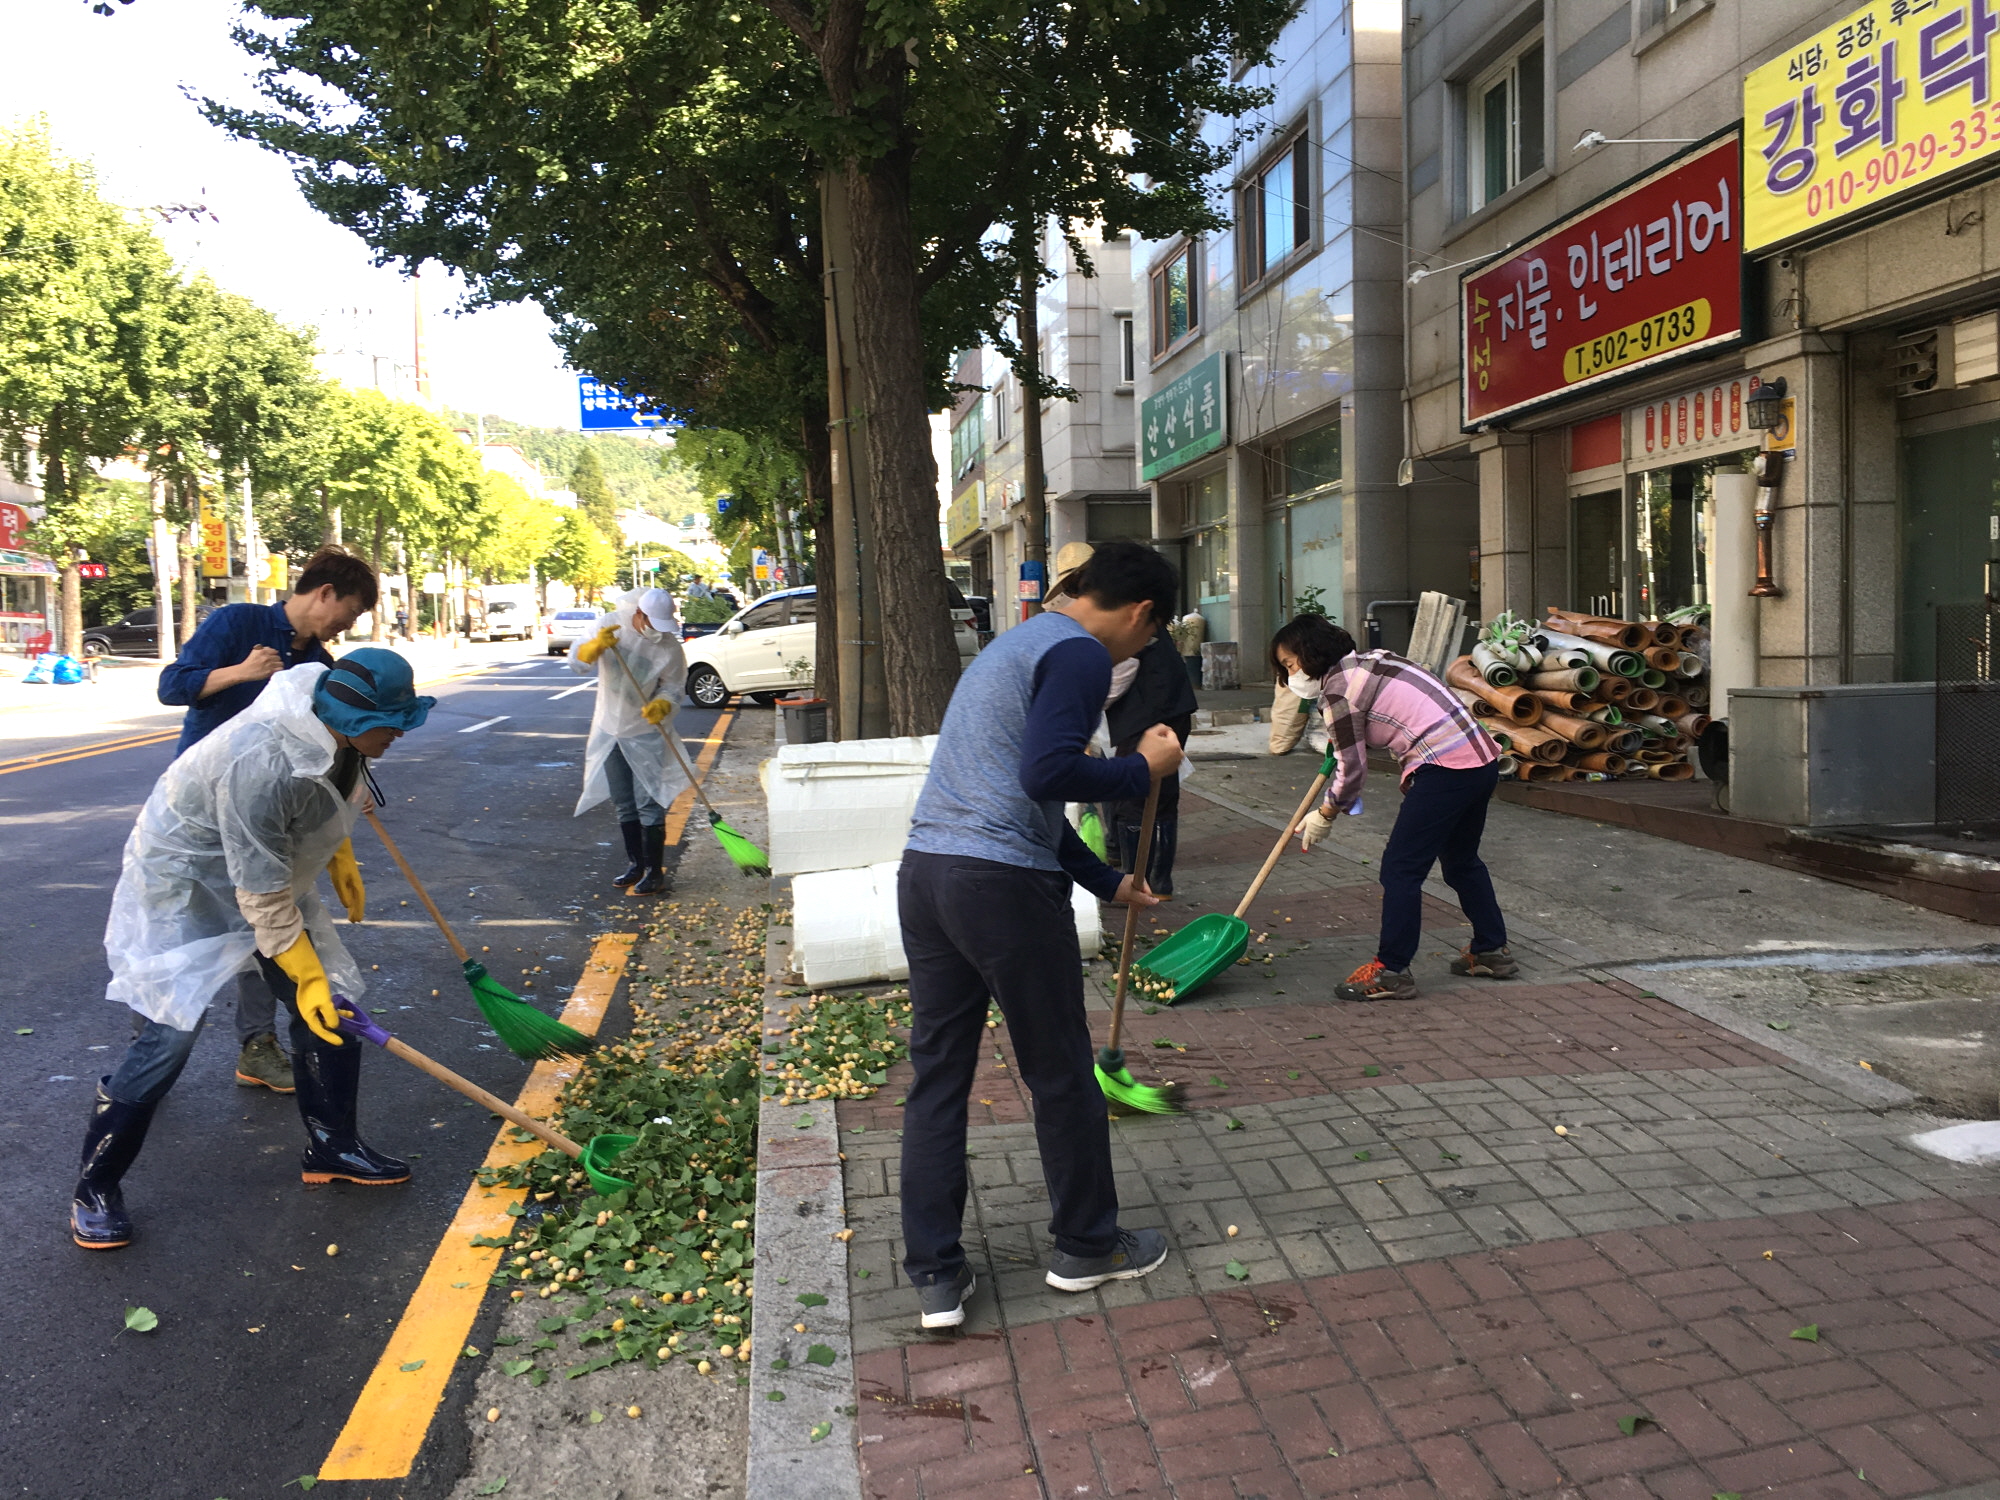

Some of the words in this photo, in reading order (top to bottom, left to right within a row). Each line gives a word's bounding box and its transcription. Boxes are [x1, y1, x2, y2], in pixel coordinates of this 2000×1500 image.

[1787, 43, 1829, 82] 식당,
[1836, 13, 1882, 59] 공장,
[1575, 305, 1696, 375] T.502-9733
[1146, 380, 1217, 458] 안산식품
